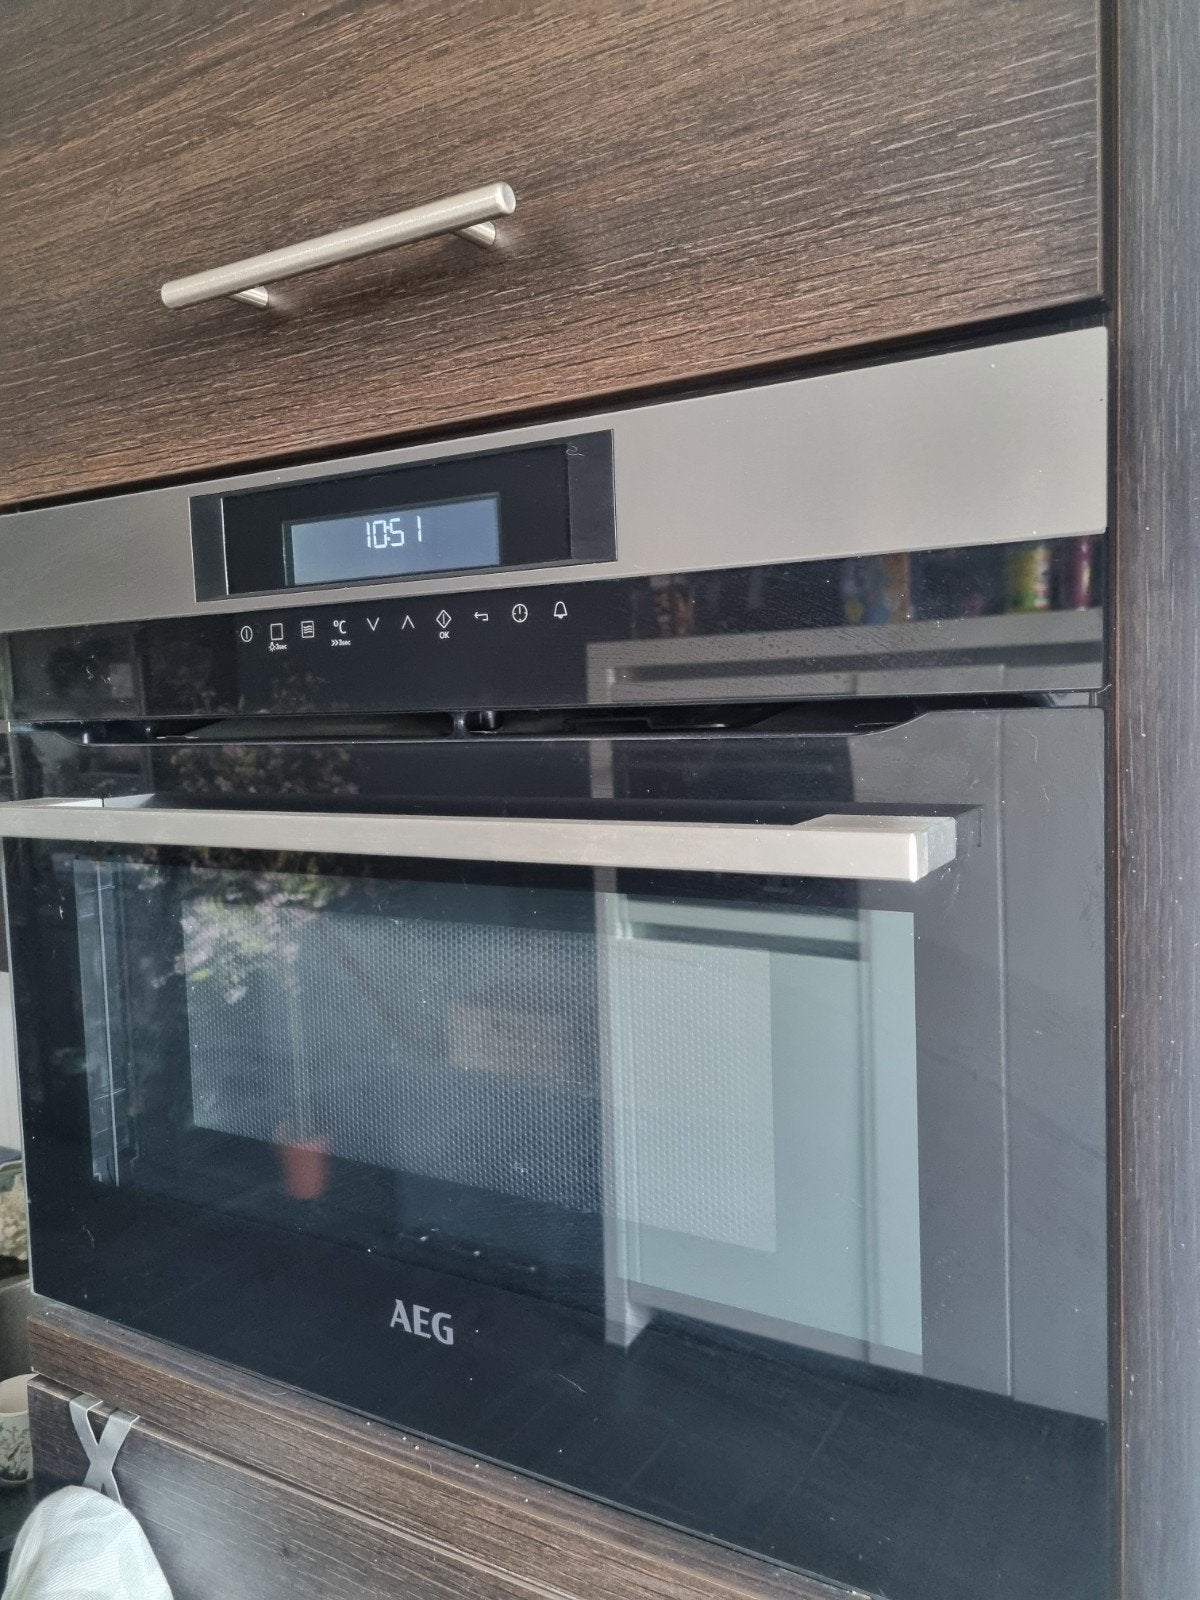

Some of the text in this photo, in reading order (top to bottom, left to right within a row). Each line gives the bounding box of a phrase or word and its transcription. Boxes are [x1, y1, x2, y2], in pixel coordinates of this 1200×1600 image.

[366, 515, 422, 549] 10:51
[439, 631, 450, 639] OK
[390, 1299, 454, 1345] AEG
